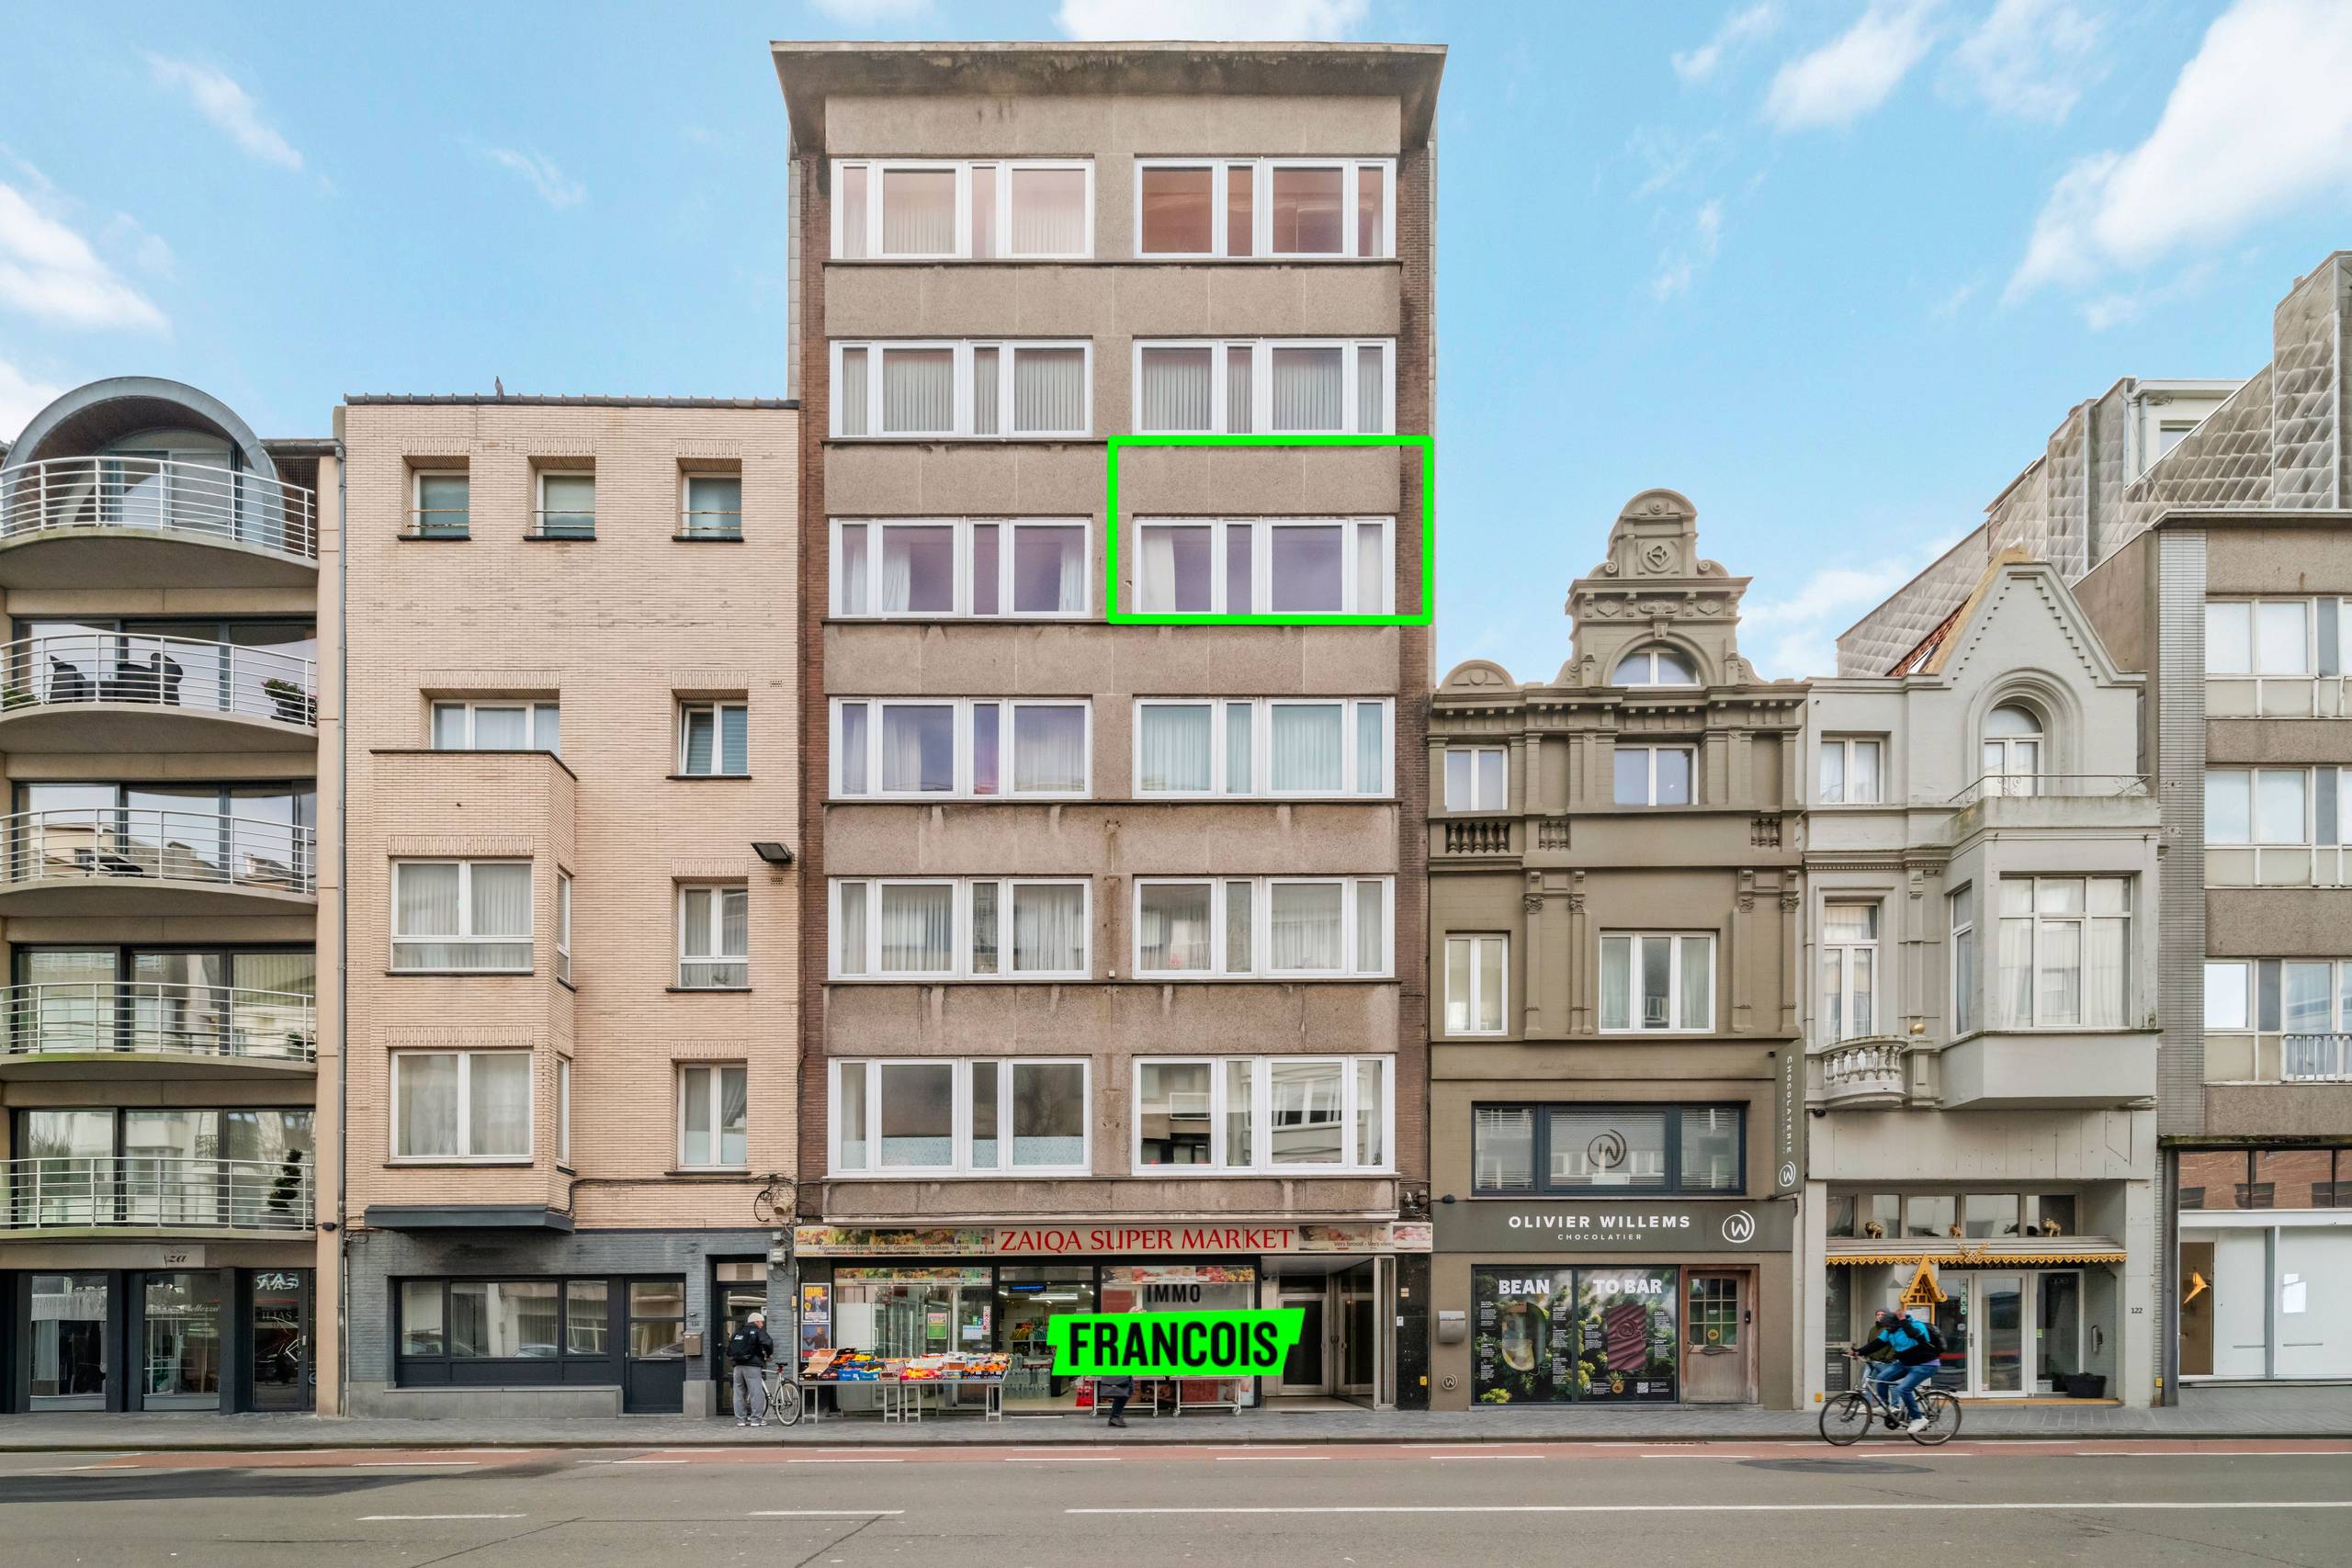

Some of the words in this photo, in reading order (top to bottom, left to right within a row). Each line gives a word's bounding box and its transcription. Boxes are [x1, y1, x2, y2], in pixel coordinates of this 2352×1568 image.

[1508, 1215, 1590, 1228] OLIVIER
[1600, 1215, 1690, 1228] WILLEMS
[1000, 1230, 1082, 1253] ZAIQA
[1091, 1229, 1174, 1250] SUPER
[1182, 1228, 1295, 1249] MARKET
[1498, 1279, 1550, 1294] BEAN
[1592, 1279, 1620, 1294] TO
[1624, 1279, 1662, 1294] BAR
